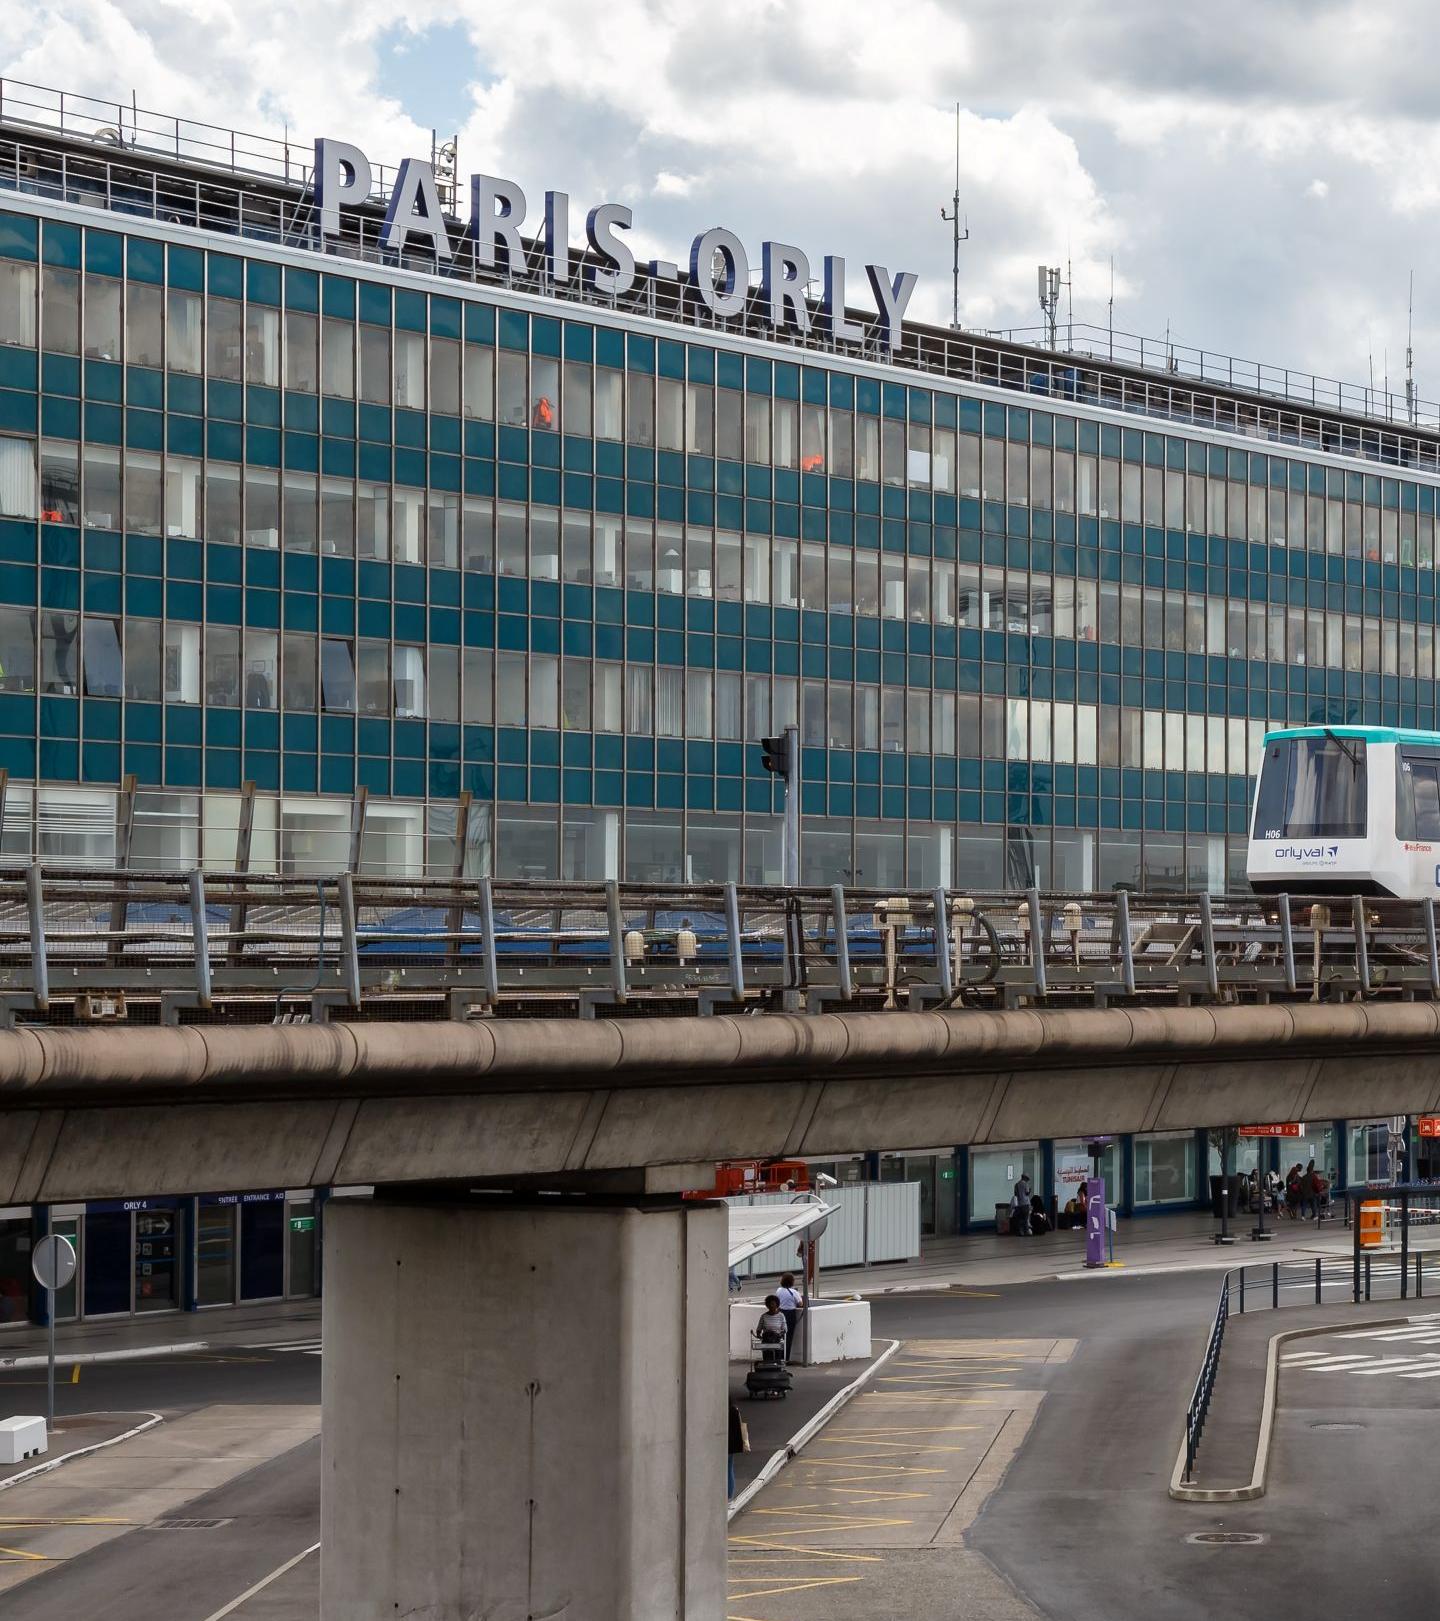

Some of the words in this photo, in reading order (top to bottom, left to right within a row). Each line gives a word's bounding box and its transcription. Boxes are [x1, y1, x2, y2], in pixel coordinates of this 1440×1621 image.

[1265, 830, 1281, 839] H06
[1275, 846, 1324, 859] orlyval
[243, 1193, 270, 1202] ENTRANCE
[123, 1201, 141, 1210] ORLY
[141, 1200, 147, 1209] 4
